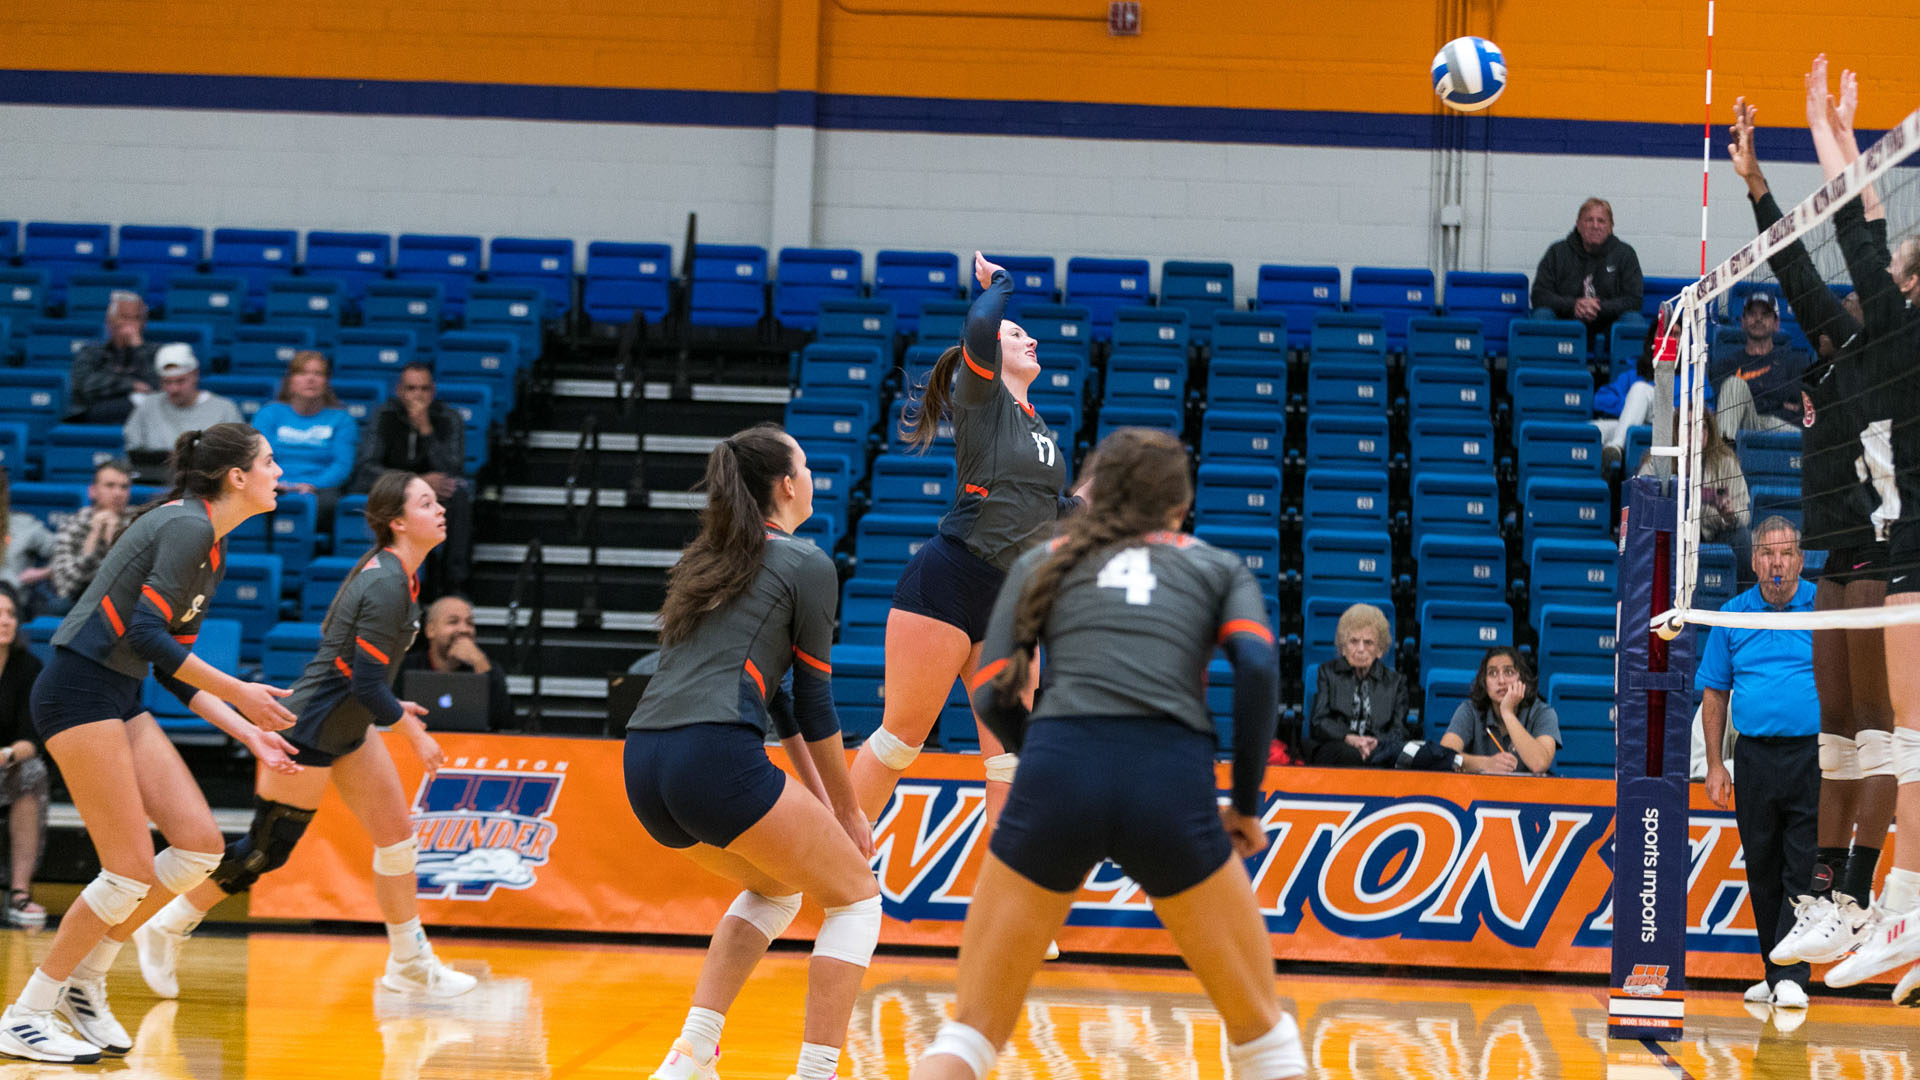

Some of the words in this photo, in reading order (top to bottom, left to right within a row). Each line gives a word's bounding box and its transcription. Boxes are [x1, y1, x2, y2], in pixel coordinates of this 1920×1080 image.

[1031, 431, 1055, 467] 17
[1097, 547, 1157, 606] 4
[443, 757, 569, 772] HEATON
[411, 816, 554, 859] HUNDER
[869, 785, 1592, 931] WTON
[1642, 807, 1660, 868] sports
[1640, 869, 1658, 943] imports
